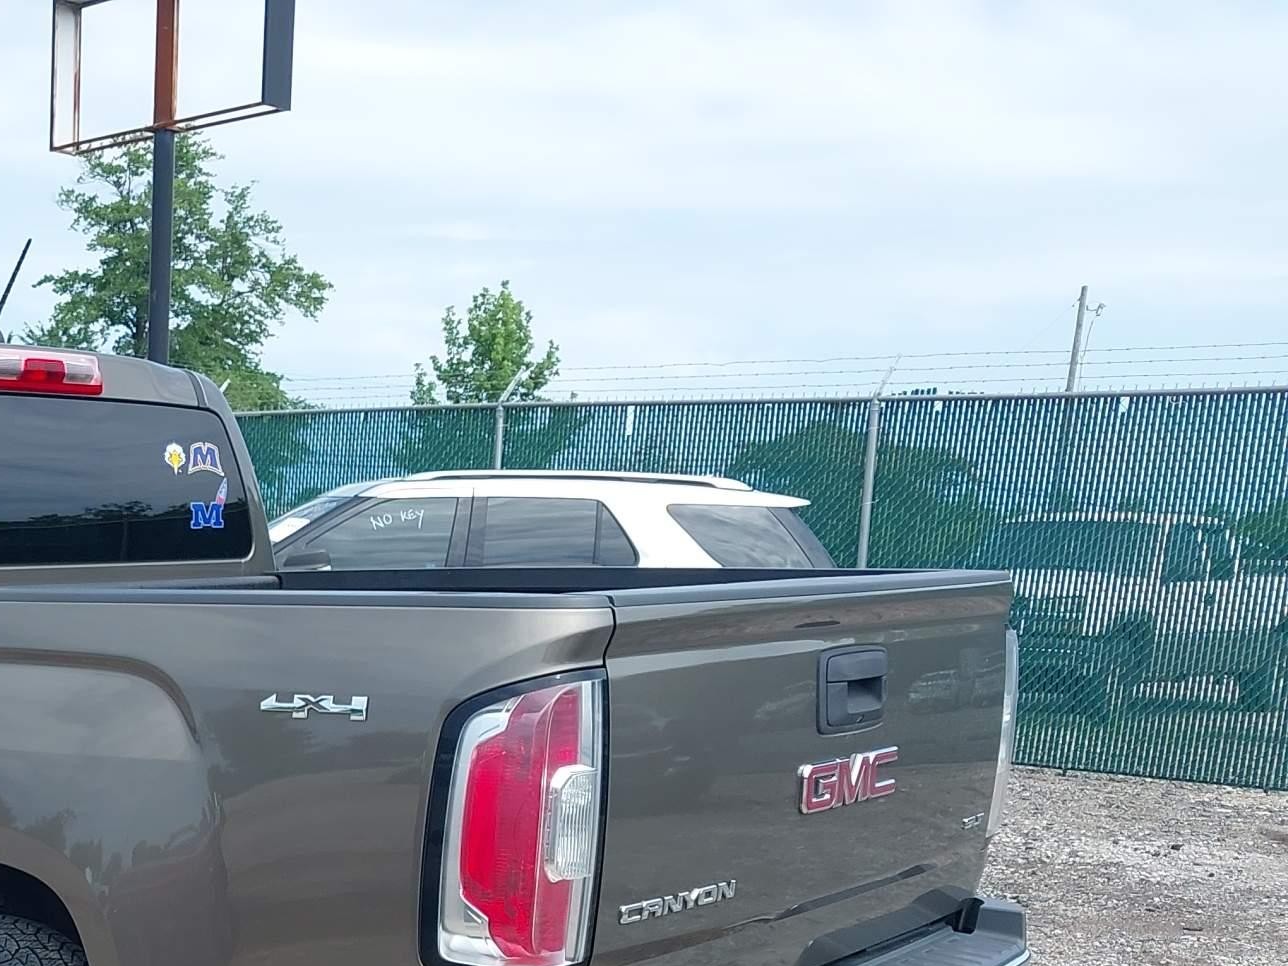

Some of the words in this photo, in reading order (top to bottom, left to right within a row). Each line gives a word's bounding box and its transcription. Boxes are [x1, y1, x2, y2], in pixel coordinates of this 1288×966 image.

[190, 501, 225, 530] M
[370, 513, 393, 530] NO
[400, 508, 425, 529] KEY
[798, 746, 899, 814] GMC
[618, 879, 737, 925] CANYON
